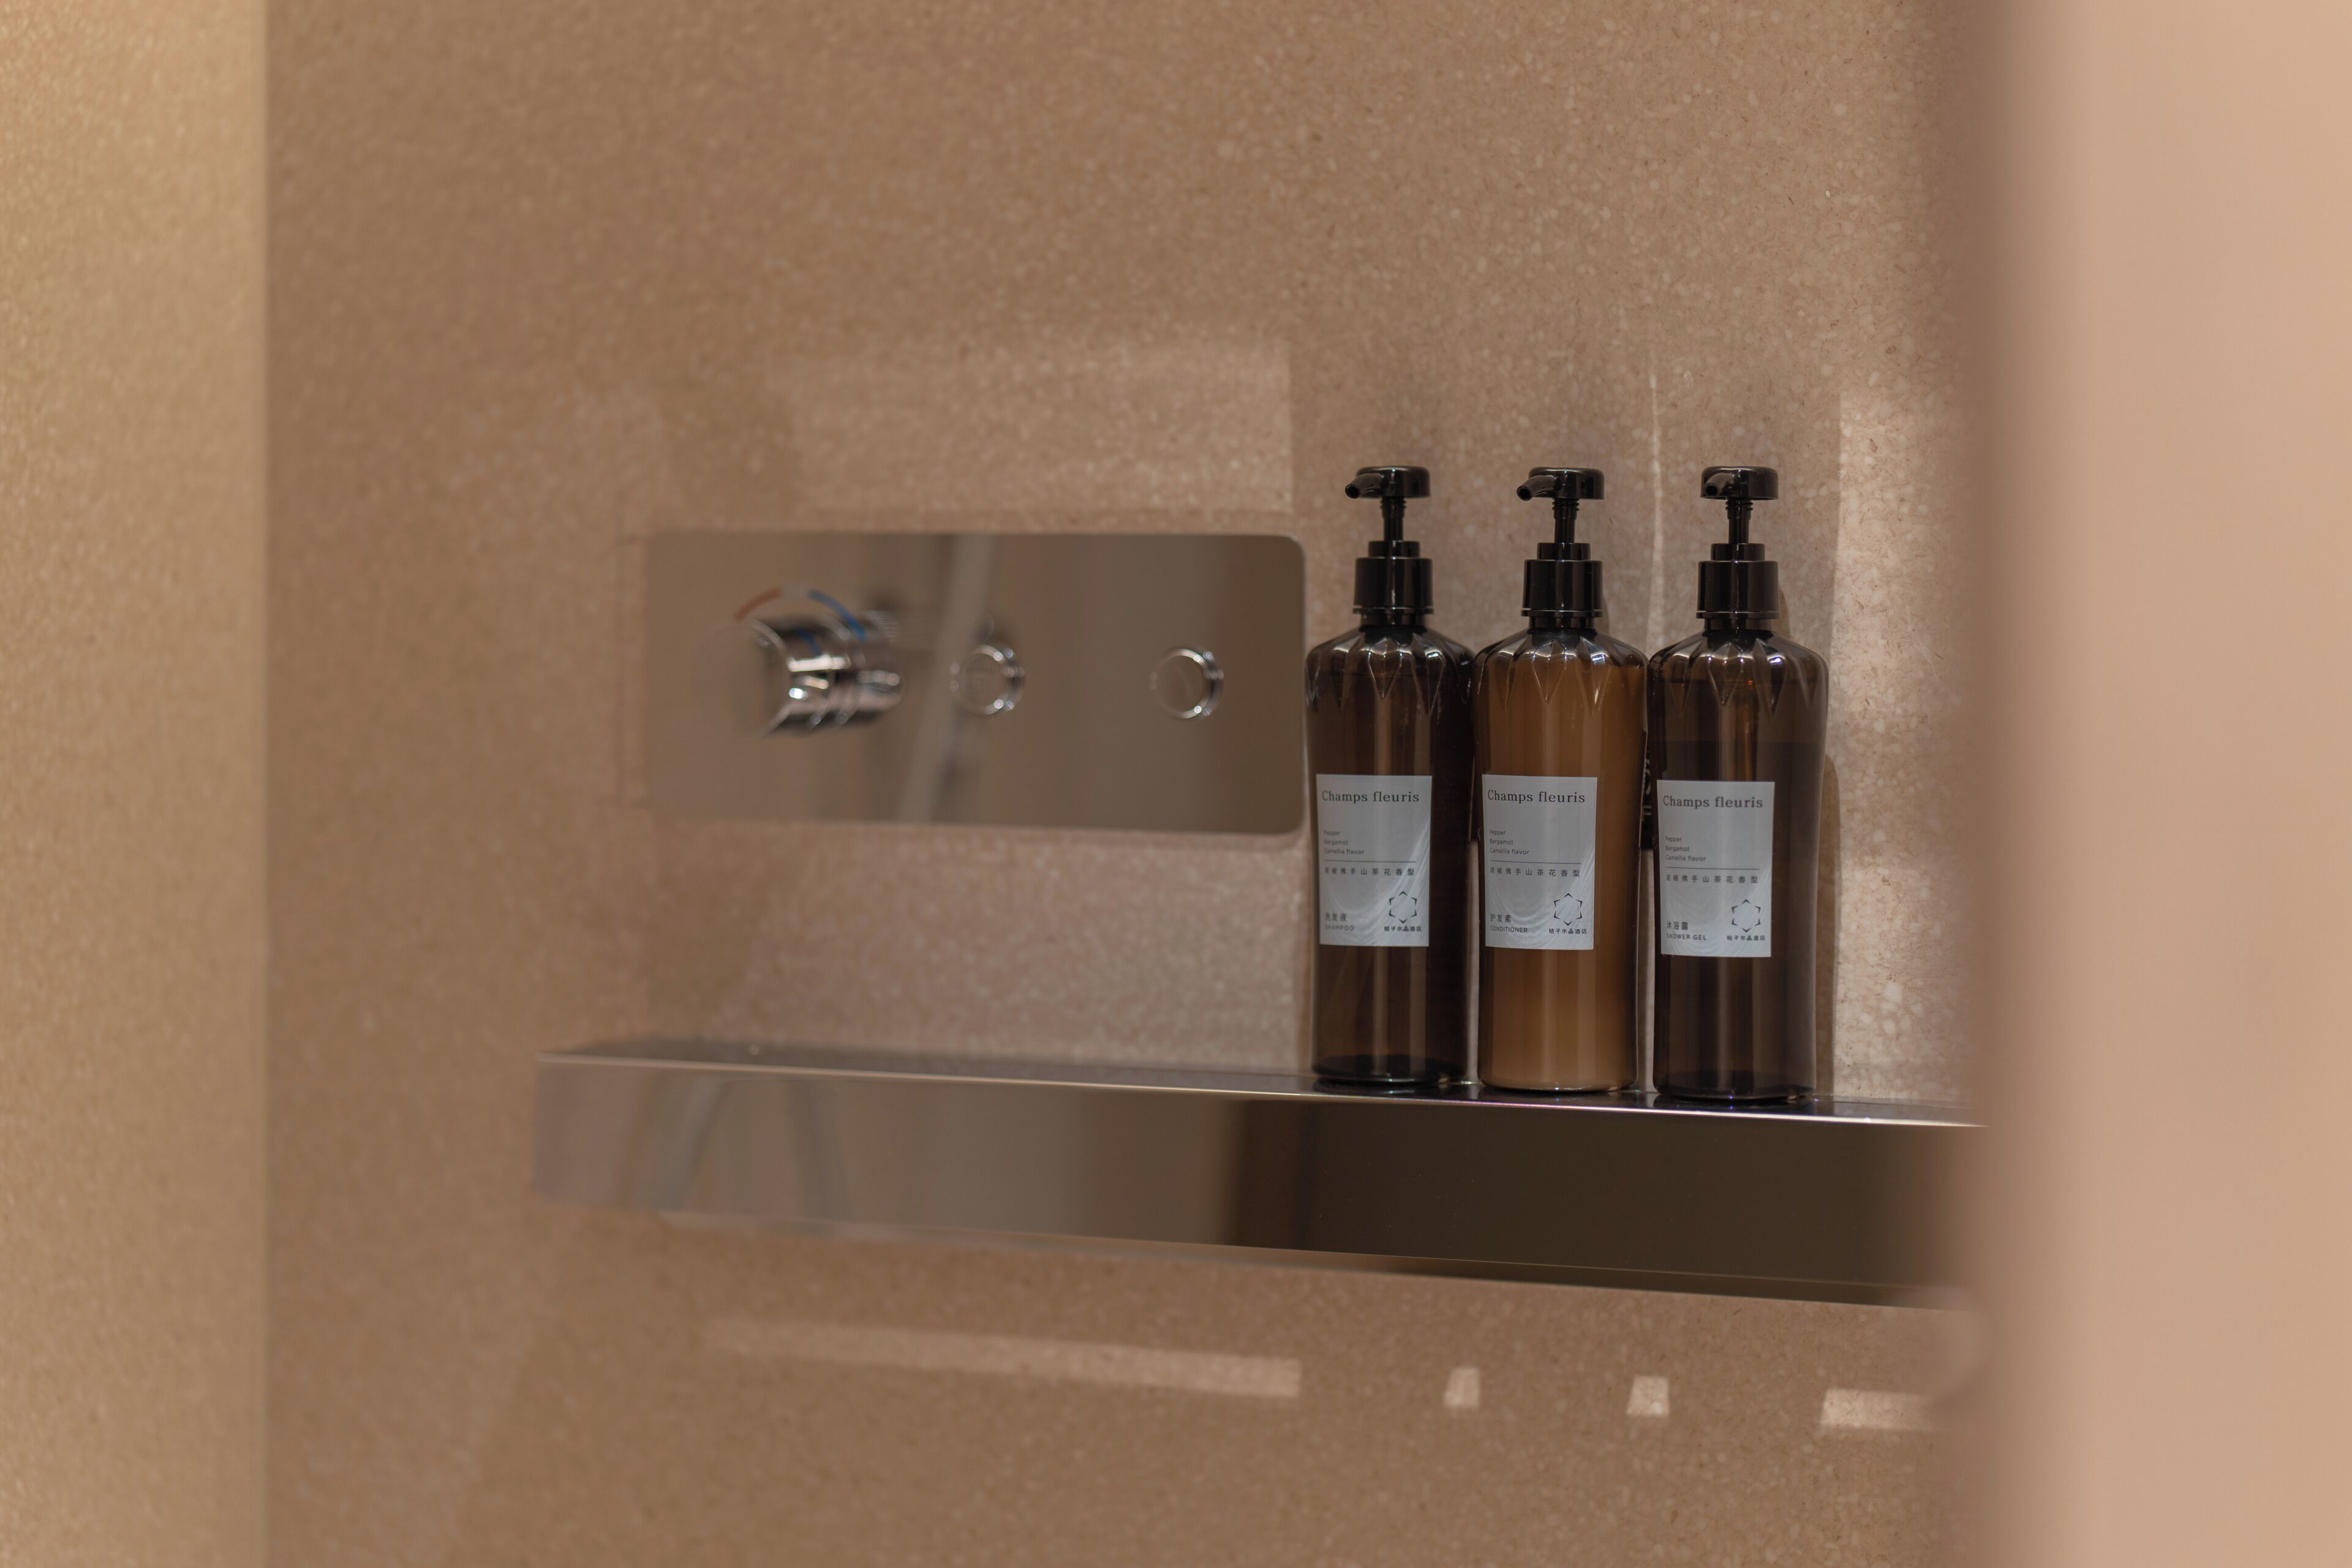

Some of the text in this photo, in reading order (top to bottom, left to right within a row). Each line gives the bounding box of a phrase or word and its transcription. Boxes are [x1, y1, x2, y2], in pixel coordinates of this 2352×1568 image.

[1322, 790, 1419, 804] Champs fleuris
[1488, 790, 1585, 804] Champs fleuris
[1663, 795, 1763, 809] Champs fleuris
[1490, 913, 1512, 923] 护发素
[1666, 921, 1689, 930] 沐浴露
